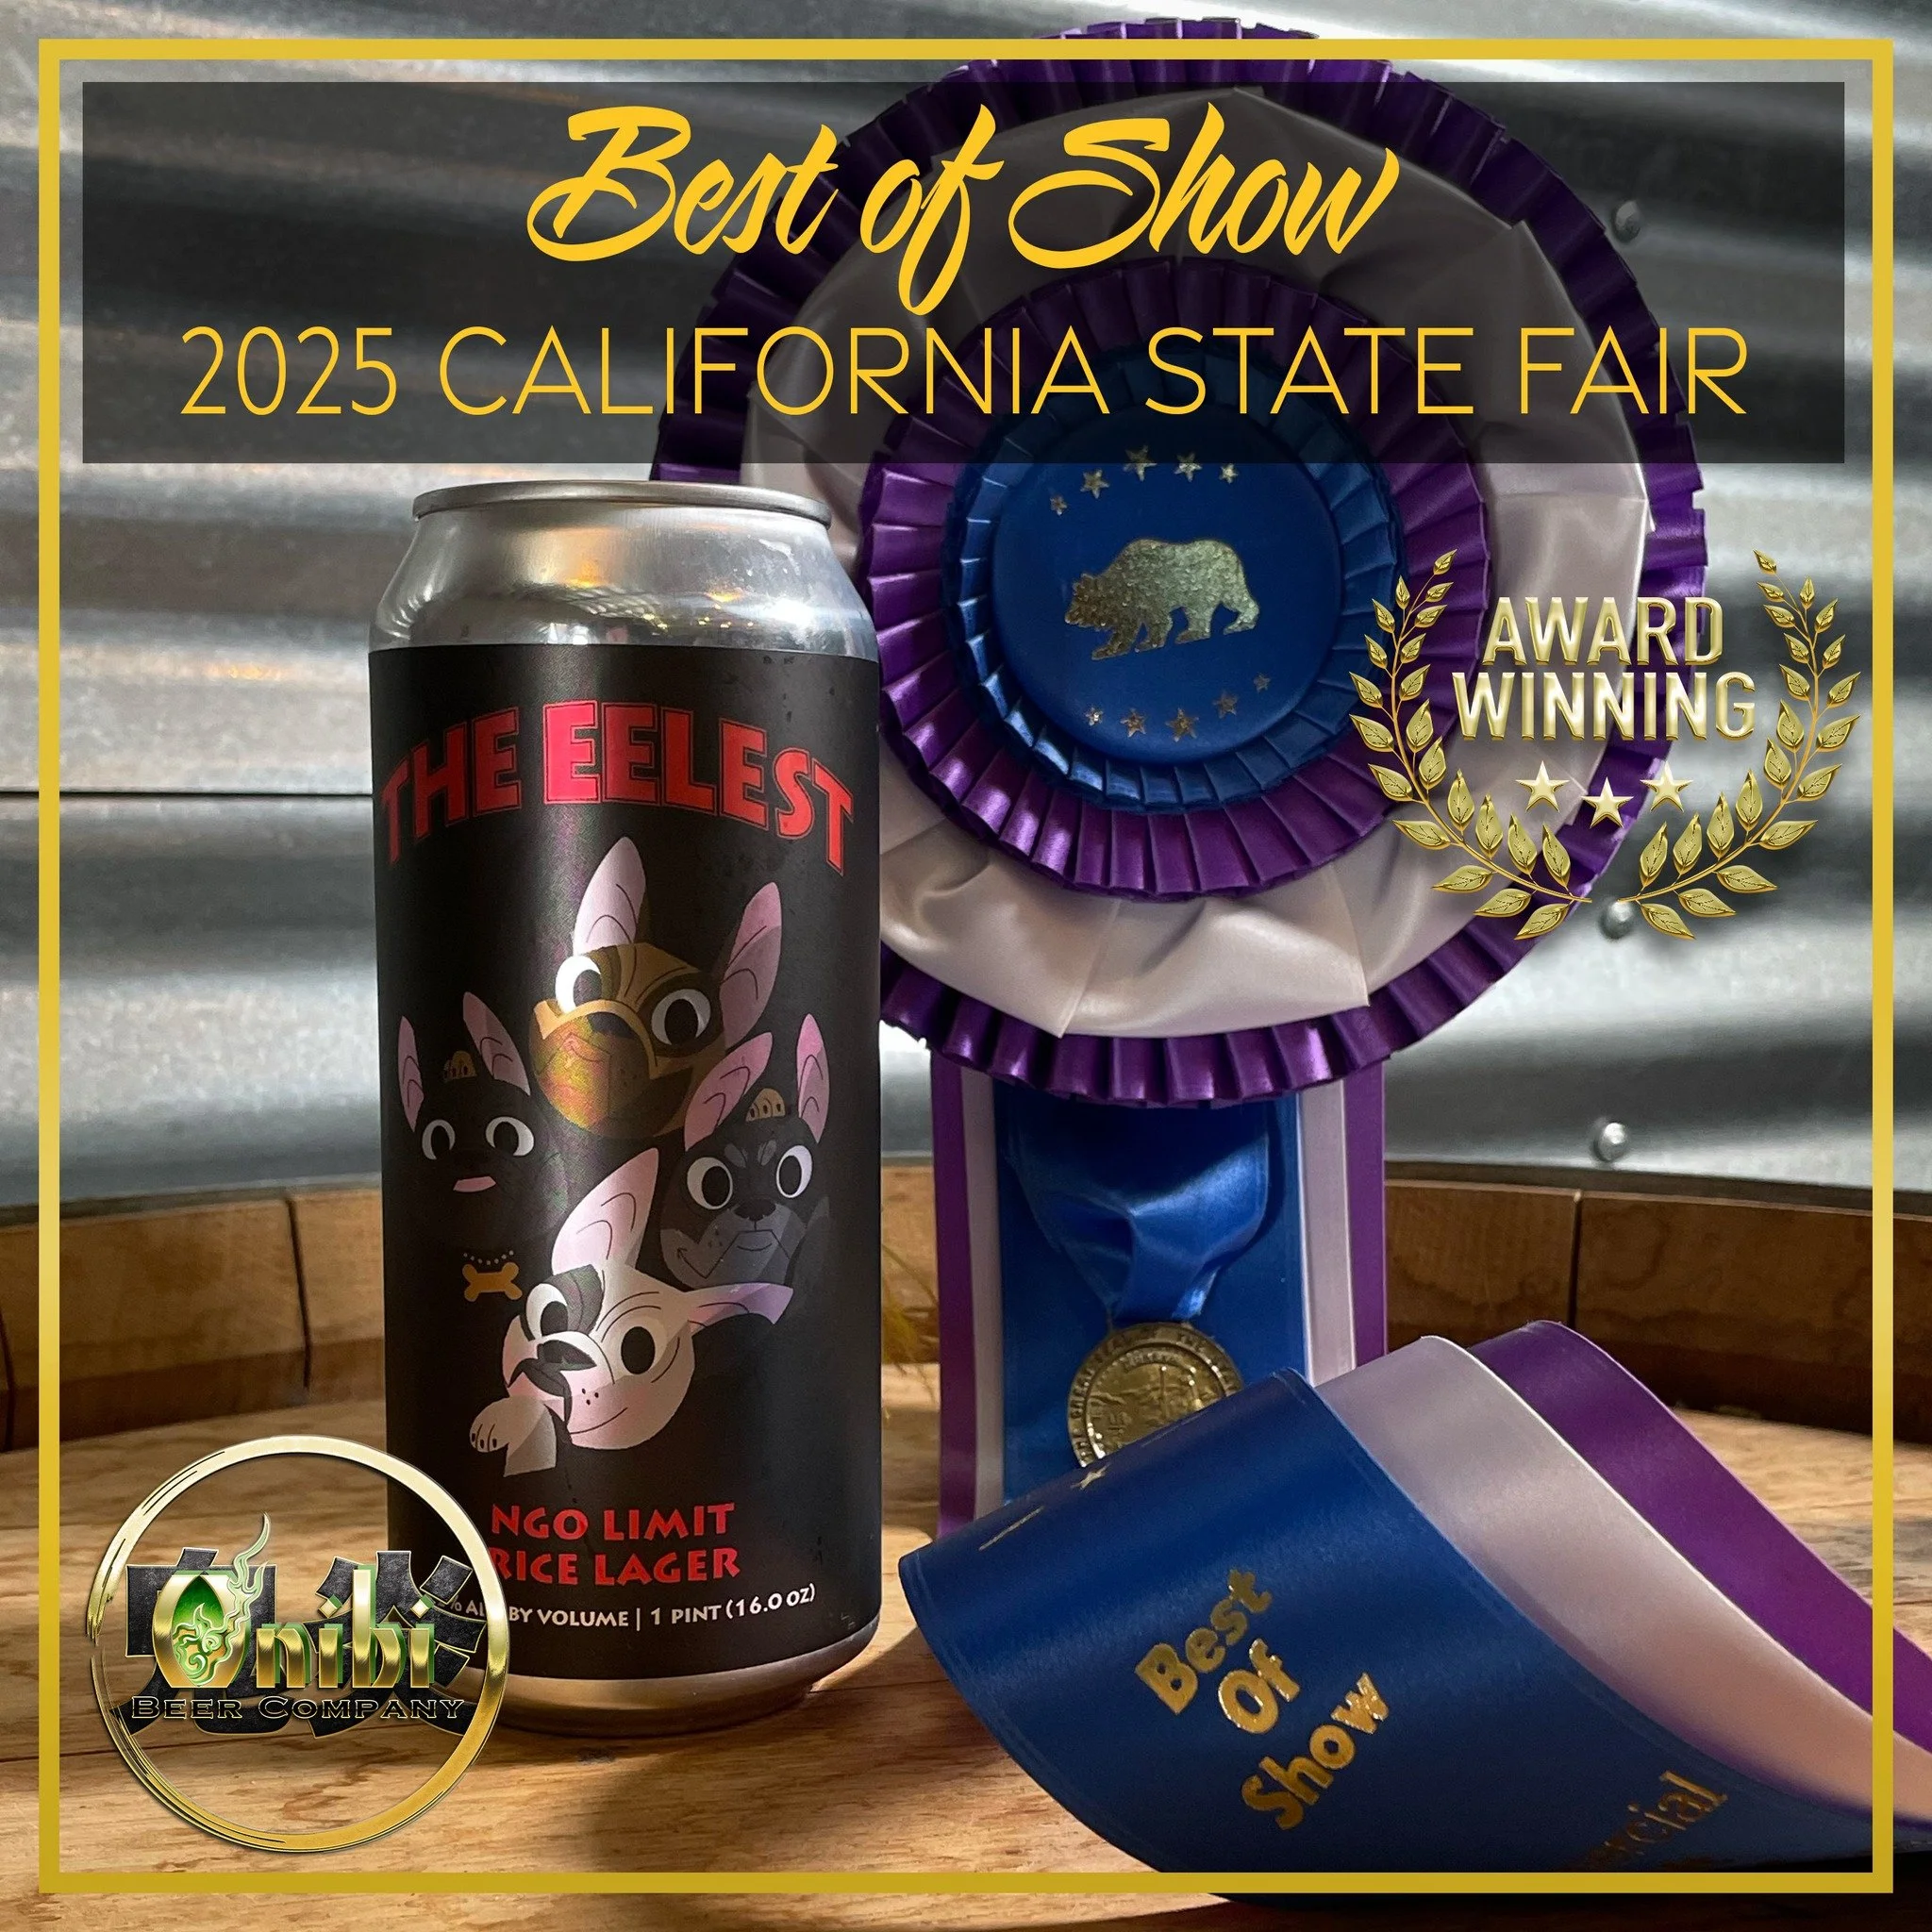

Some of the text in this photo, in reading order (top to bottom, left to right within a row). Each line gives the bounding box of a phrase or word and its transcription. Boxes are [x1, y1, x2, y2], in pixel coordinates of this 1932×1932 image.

[381, 699, 854, 876] THE EELEST
[487, 1546, 741, 1587] RICE LAGER
[491, 1503, 736, 1541] NGO LIMIT
[508, 1606, 534, 1624] BY
[537, 1608, 629, 1628] VOLUME
[650, 1607, 661, 1625] 1
[671, 1605, 723, 1624] PINT
[1134, 1569, 1273, 1715] Best
[1218, 1638, 1301, 1734] Of
[1241, 1673, 1390, 1830] Show
